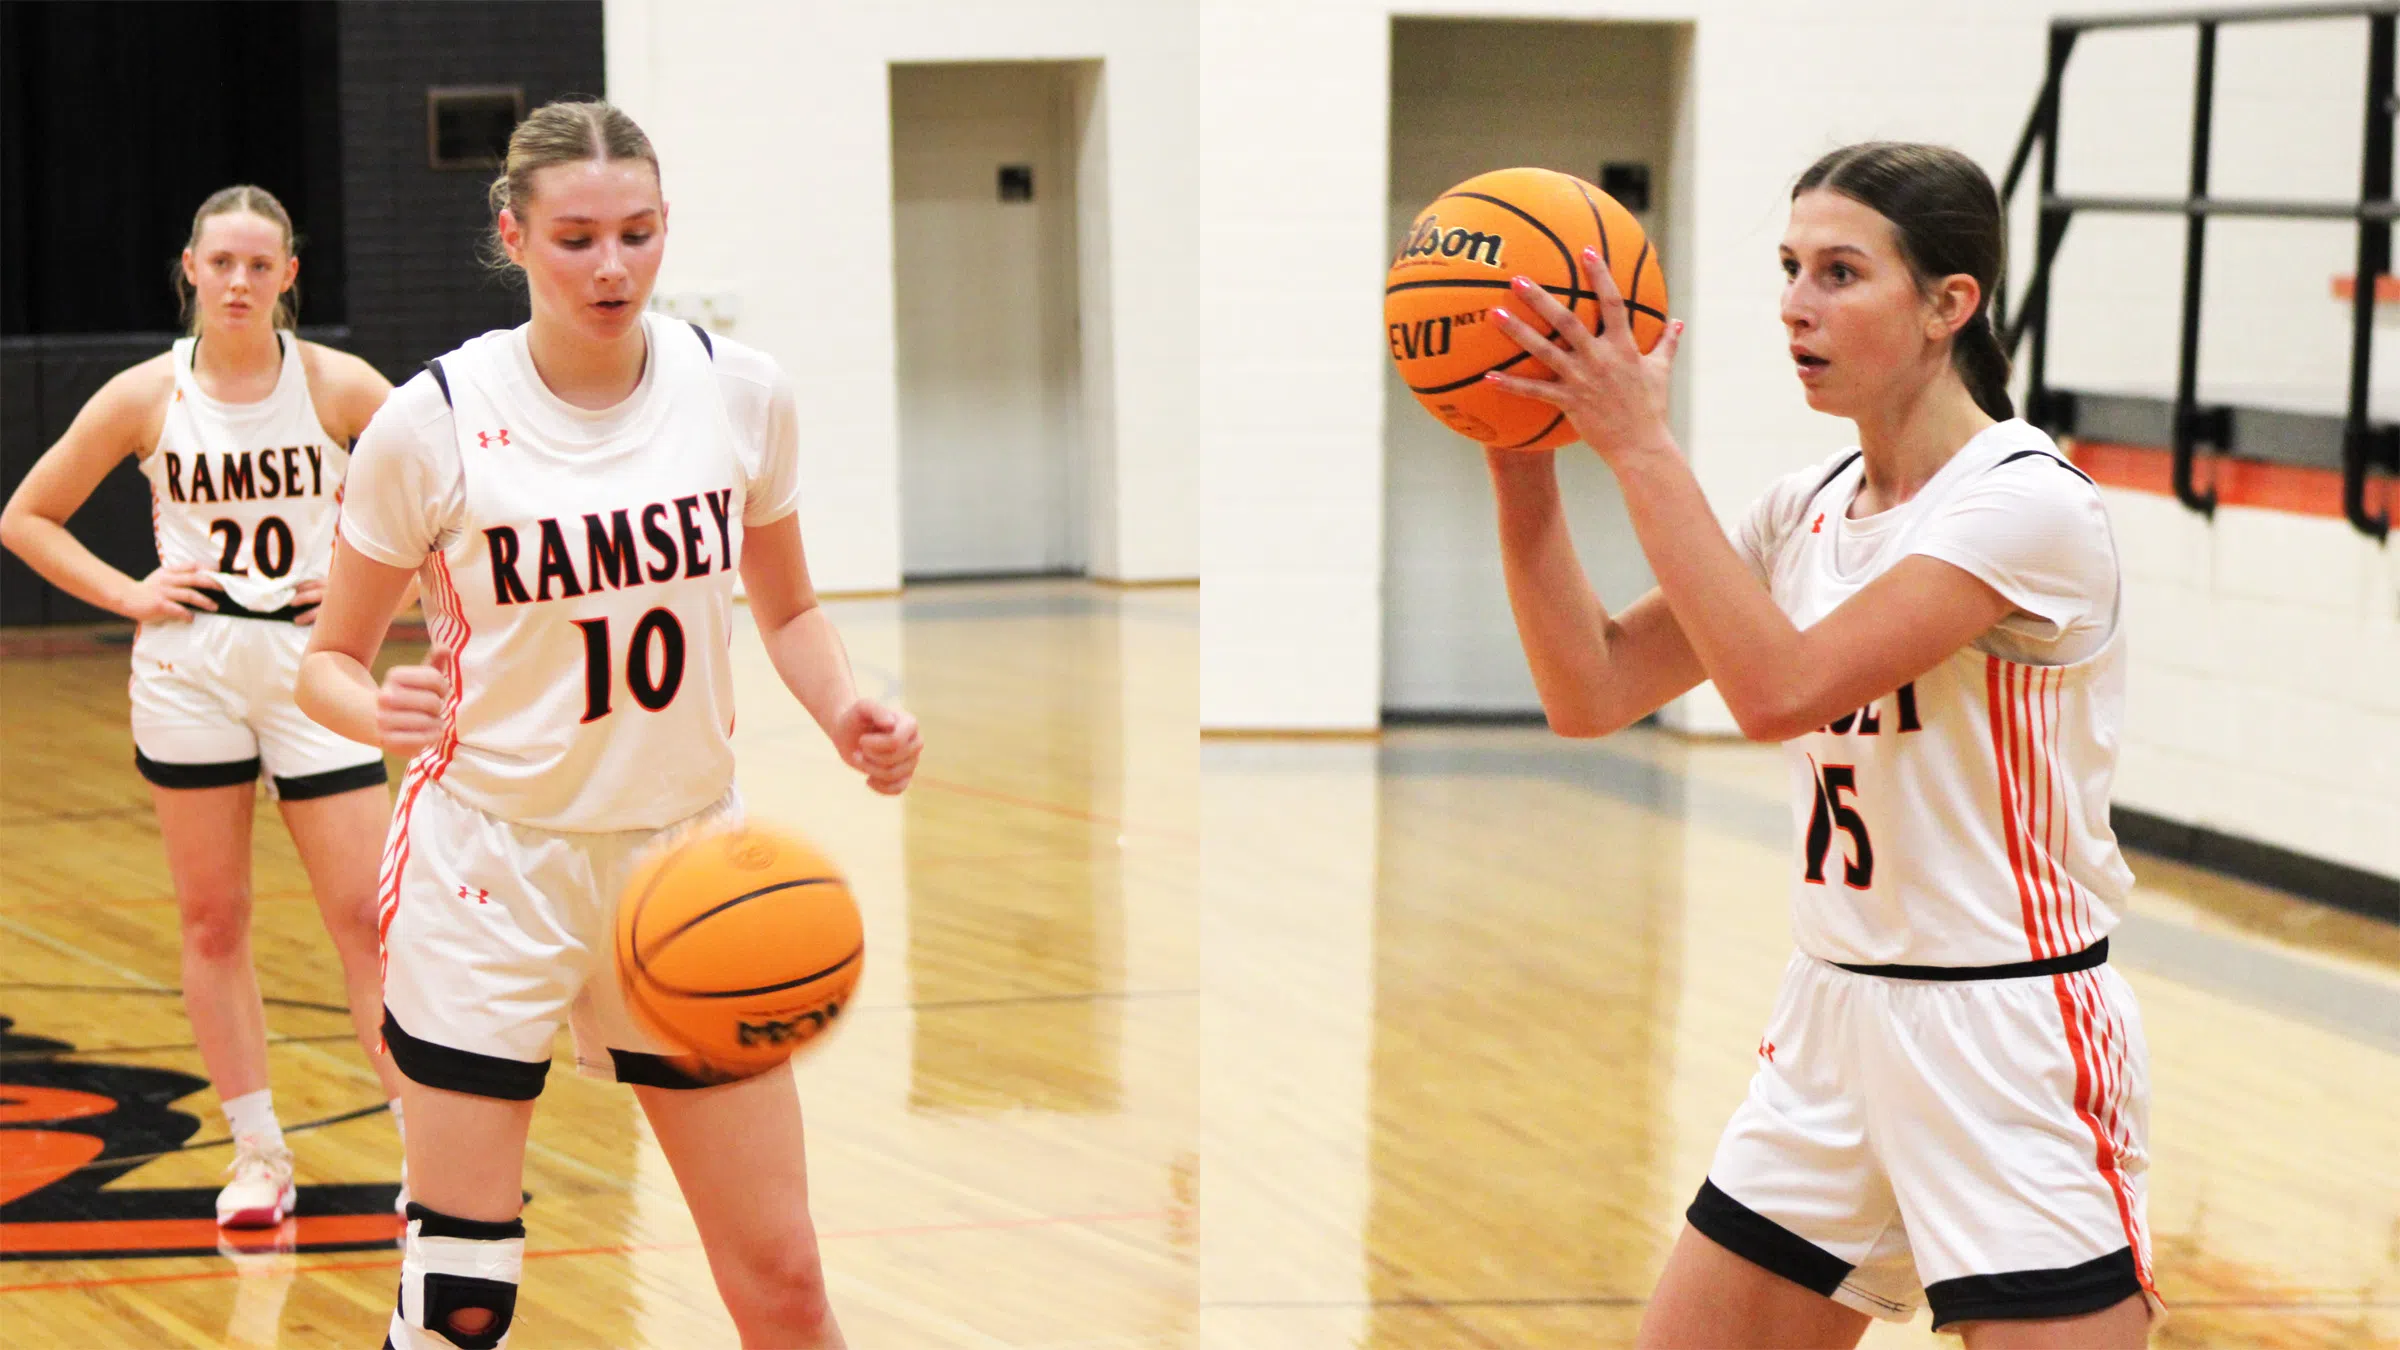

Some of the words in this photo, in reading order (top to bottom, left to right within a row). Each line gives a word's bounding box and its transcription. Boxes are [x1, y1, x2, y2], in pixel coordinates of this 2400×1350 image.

[1390, 316, 1452, 361] EVO
[164, 445, 323, 504] RAMSEY
[209, 515, 295, 581] 20
[482, 488, 732, 605] RAMSEY
[568, 606, 686, 724] 10
[1804, 752, 1874, 890] 15
